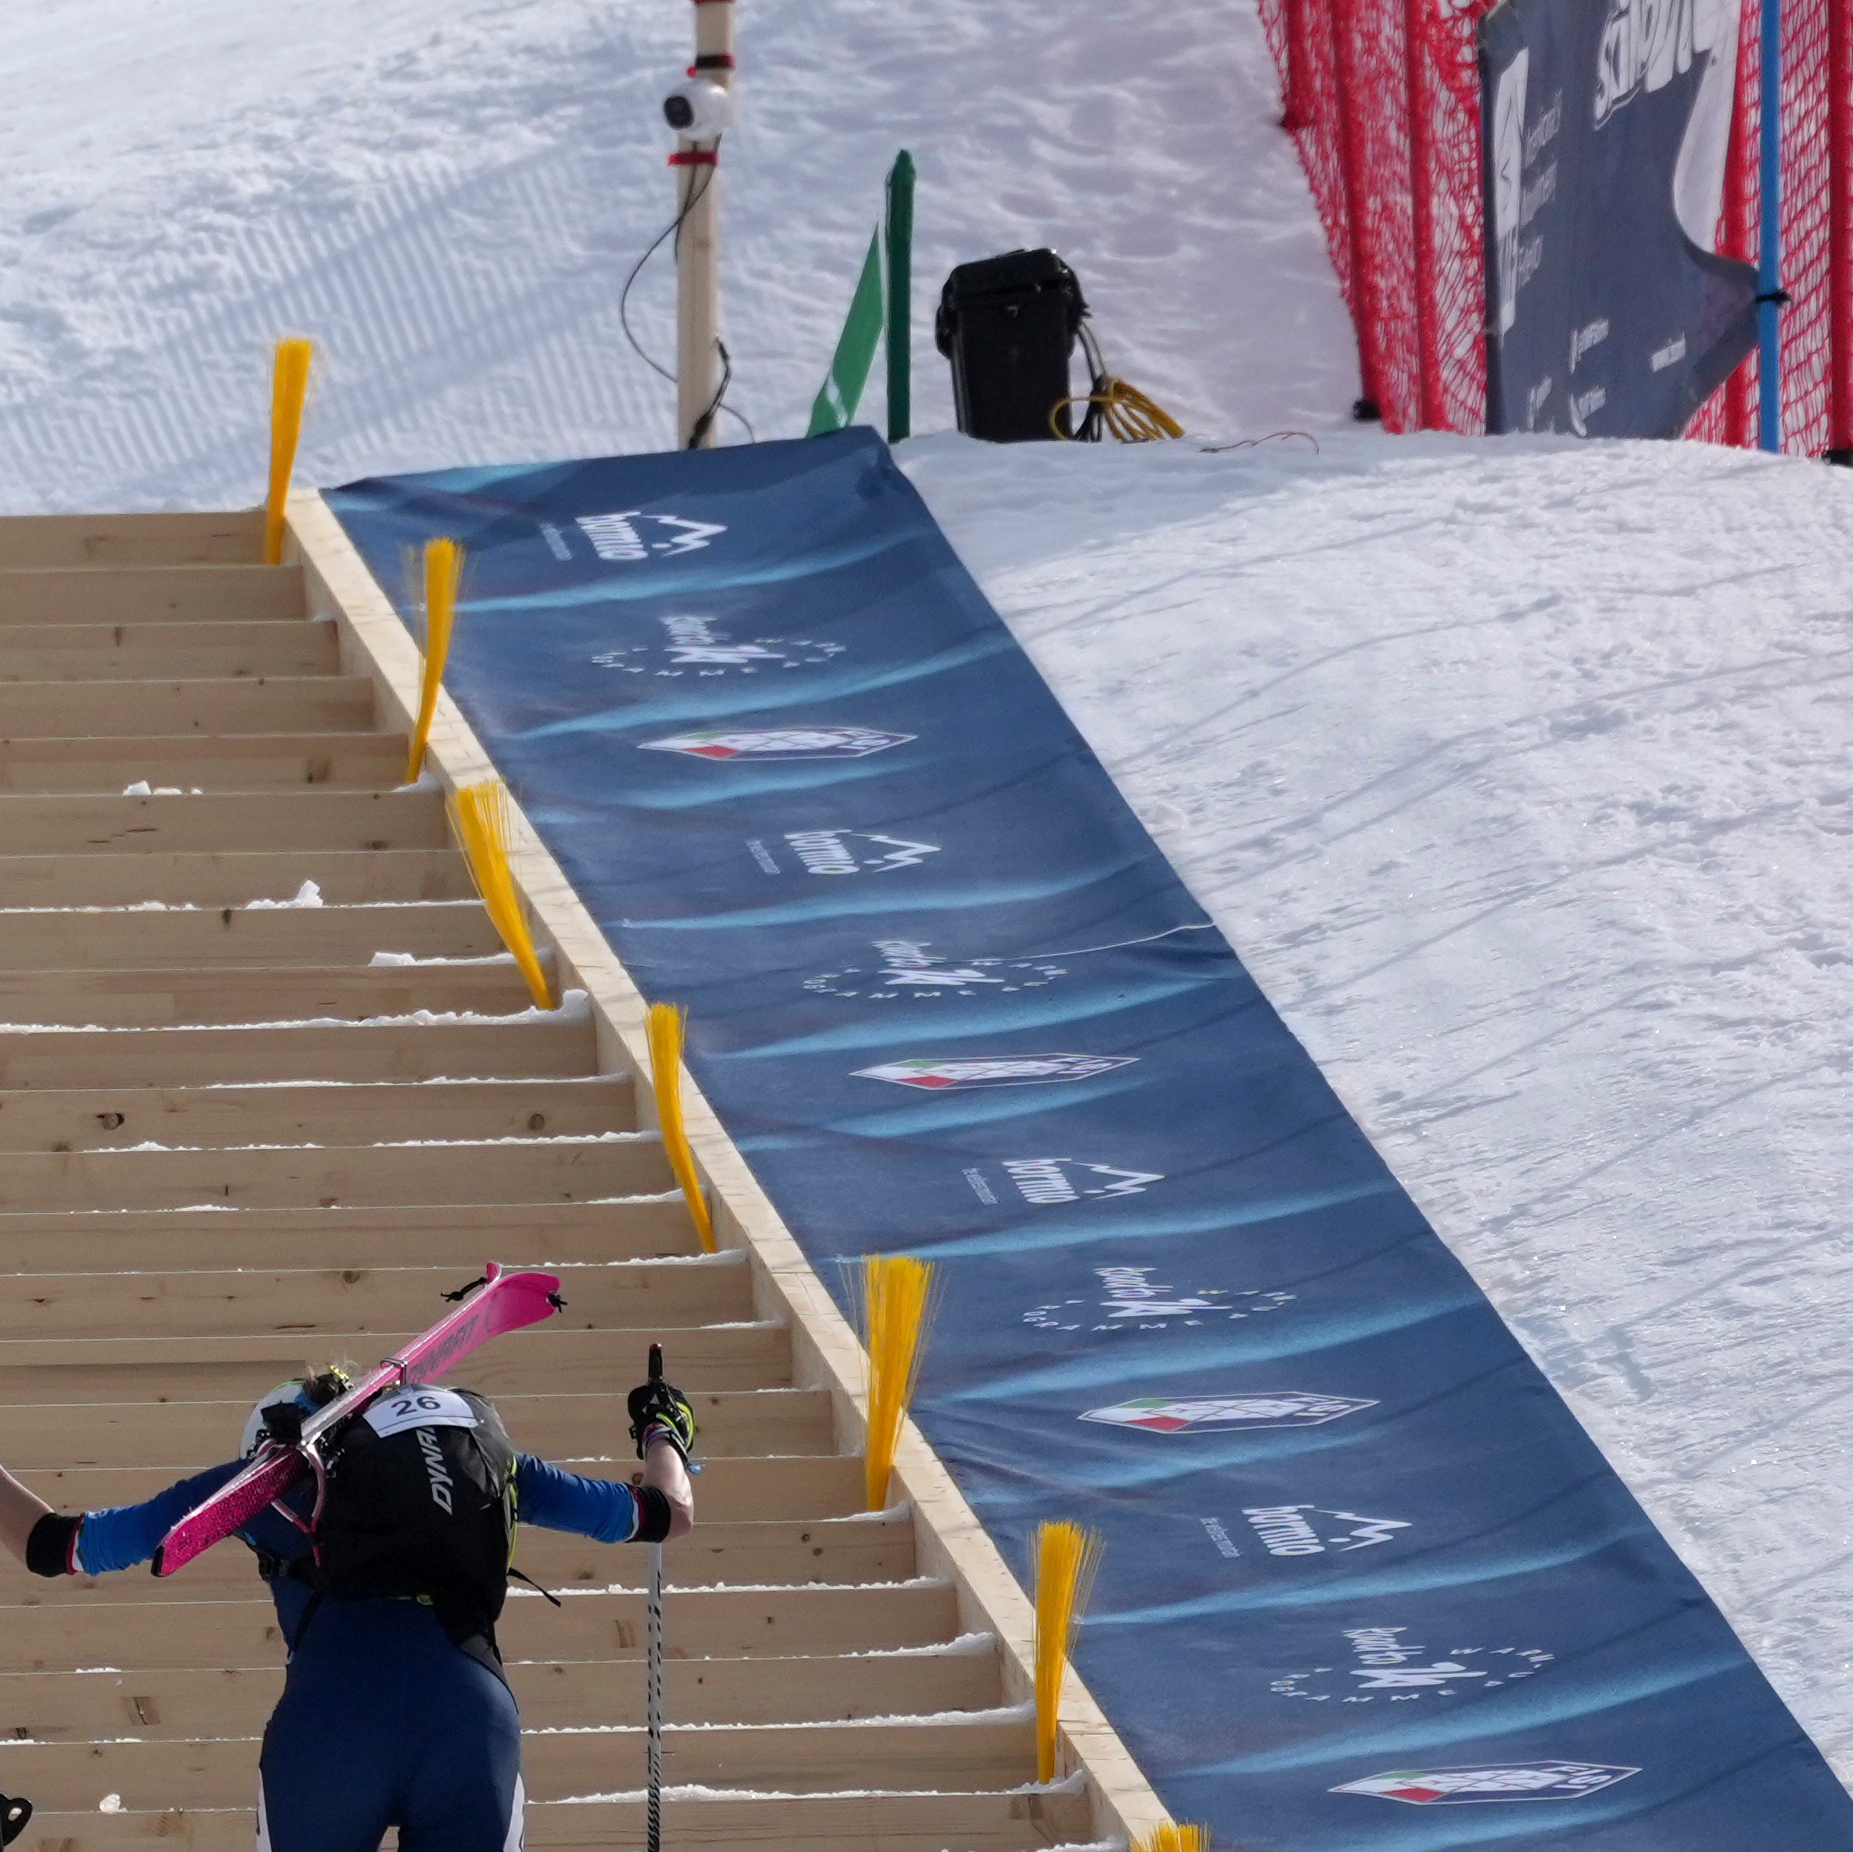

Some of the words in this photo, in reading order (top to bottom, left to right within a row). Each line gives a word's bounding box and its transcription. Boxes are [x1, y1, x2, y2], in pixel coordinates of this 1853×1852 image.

[575, 509, 649, 561] bormio
[784, 829, 860, 875] bormio
[1001, 1157, 1080, 1204] bormio
[1094, 1267, 1173, 1289] Road
[390, 1396, 441, 1417] 26
[415, 1426, 454, 1516] DYNA
[1241, 1505, 1326, 1556] bormio
[1342, 1627, 1426, 1652] Road
[1538, 1765, 1612, 1790] FISI
